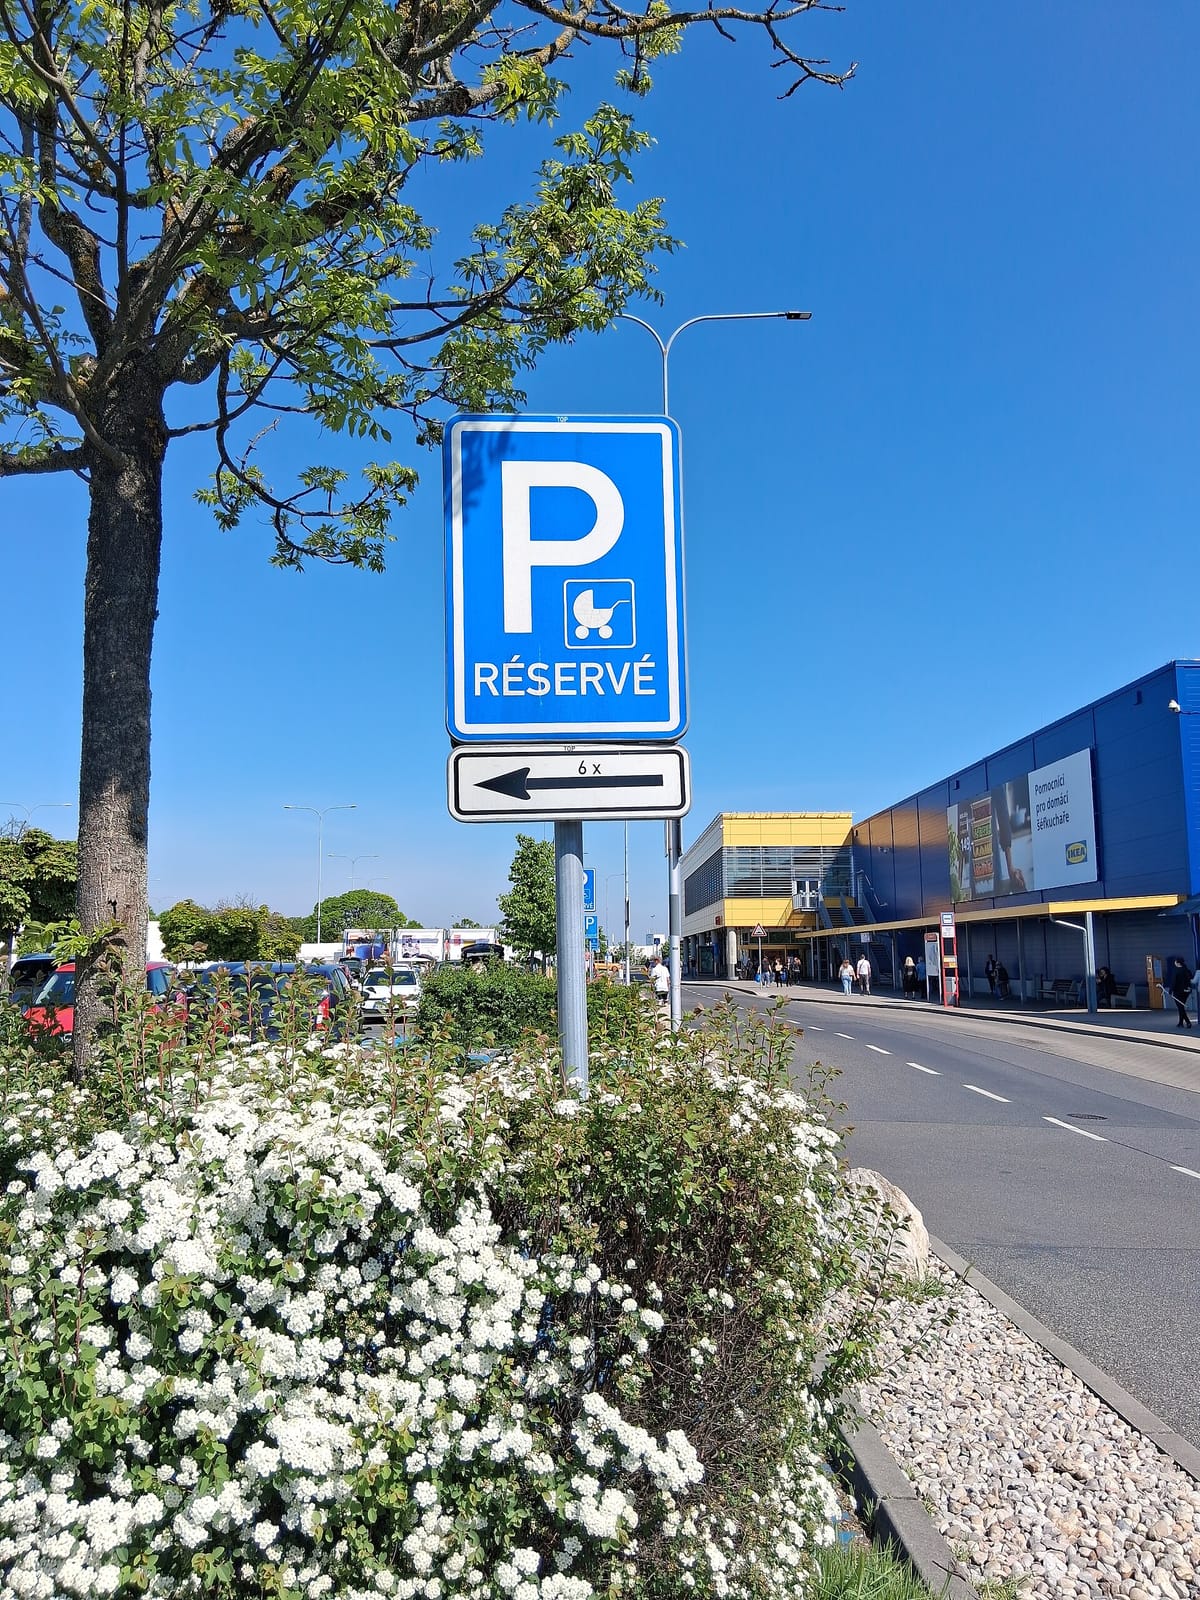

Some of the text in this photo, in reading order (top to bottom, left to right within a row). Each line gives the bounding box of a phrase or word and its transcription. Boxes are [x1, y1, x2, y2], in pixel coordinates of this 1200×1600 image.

[501, 461, 625, 634] P
[473, 654, 656, 698] RÉSERVÉ
[578, 760, 587, 775] 6
[1034, 774, 1065, 795] Pomocníci
[1035, 802, 1045, 816] pro
[1036, 811, 1070, 831] šéfkuchaře
[1067, 846, 1086, 859] IKEA
[586, 916, 595, 930] P
